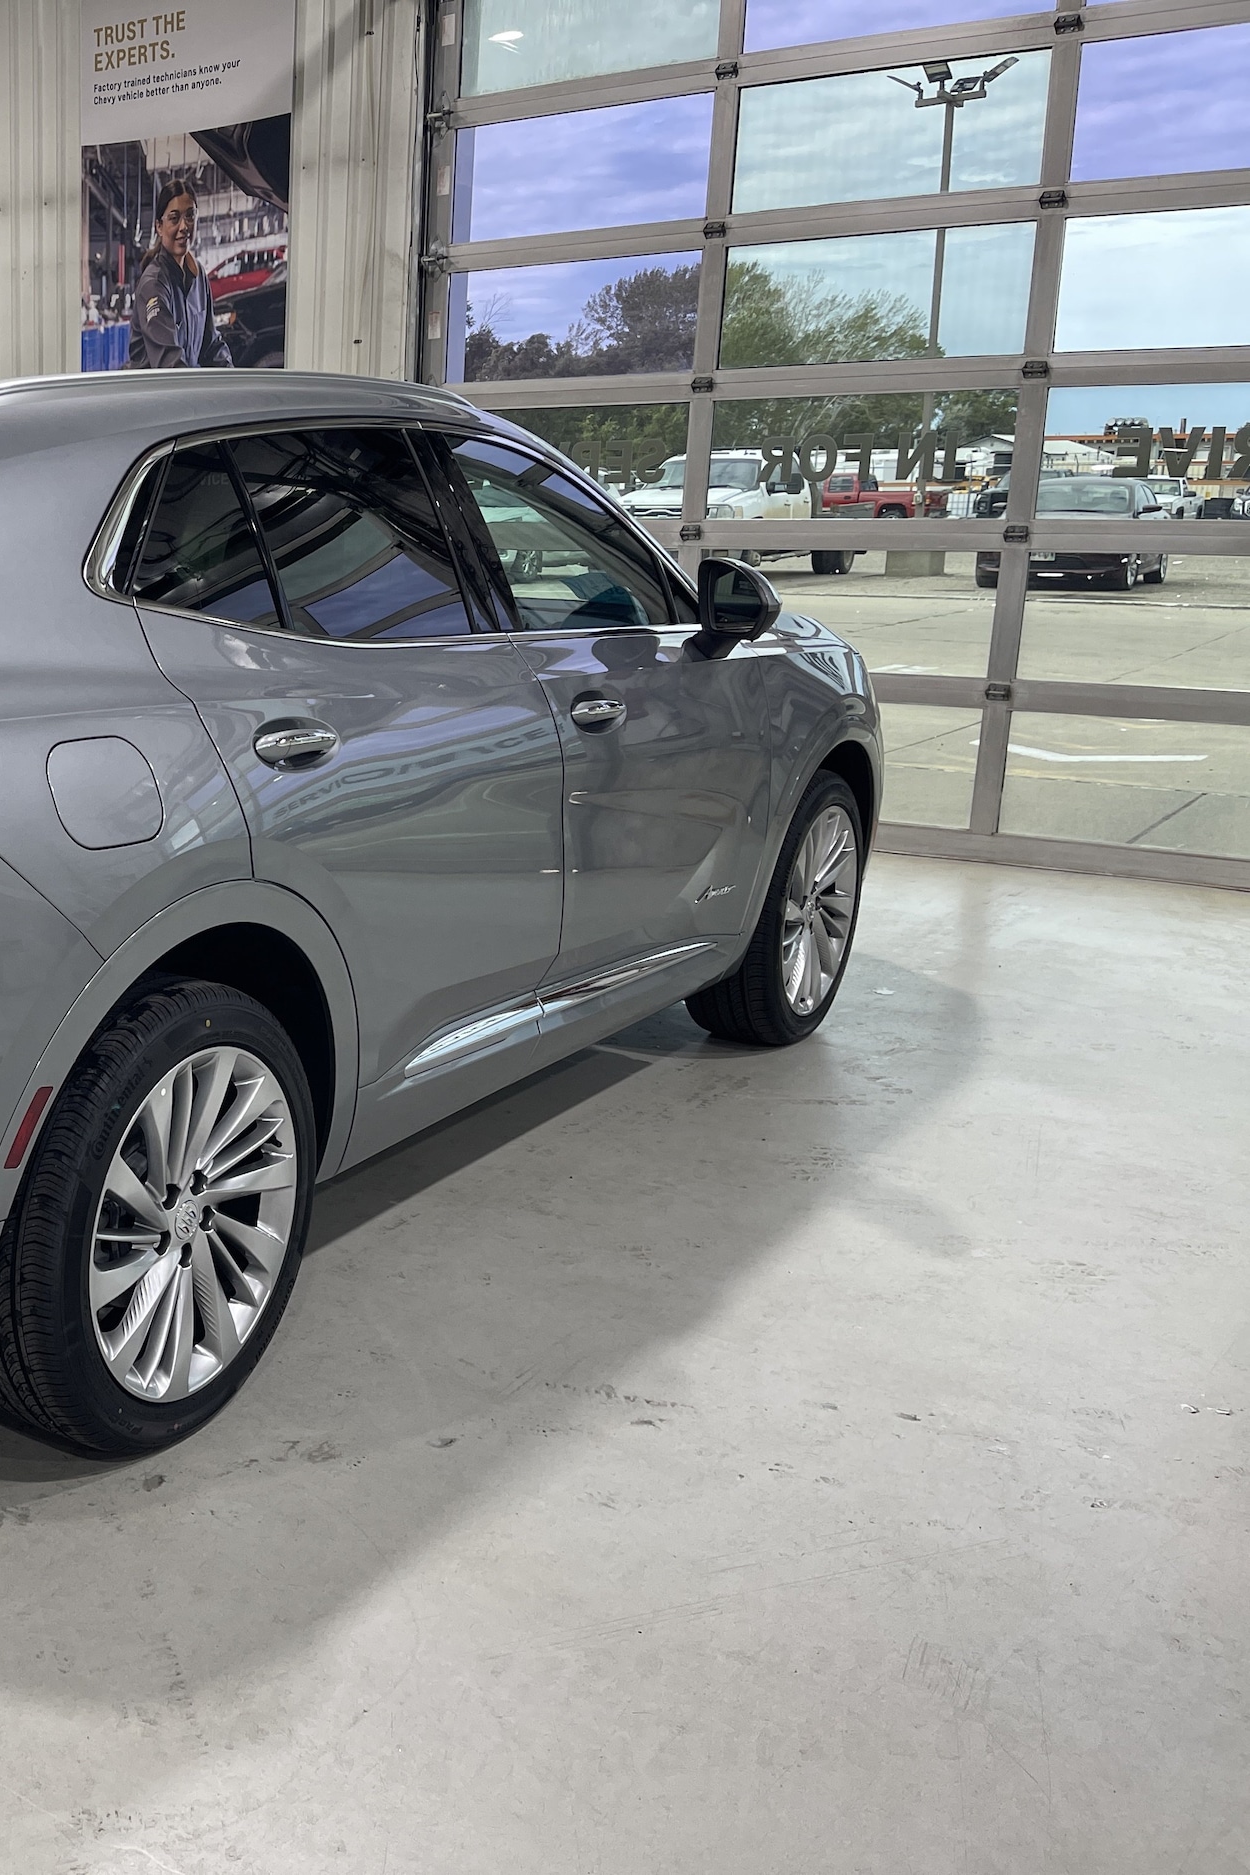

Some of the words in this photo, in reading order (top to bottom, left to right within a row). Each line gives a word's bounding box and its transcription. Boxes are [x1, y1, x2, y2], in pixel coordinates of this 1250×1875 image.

[93, 18, 147, 47] TRUST
[152, 10, 186, 35] THE
[94, 40, 175, 72] EXPERTS.
[93, 81, 122, 93] Factory
[124, 75, 151, 88] trained
[152, 69, 197, 83] technicians
[198, 65, 220, 75] know
[222, 59, 241, 73] your
[93, 96, 116, 105] Chevy
[117, 90, 144, 102] vehicle
[145, 86, 170, 98] better
[171, 82, 189, 94] than
[191, 78, 222, 90] anyone.
